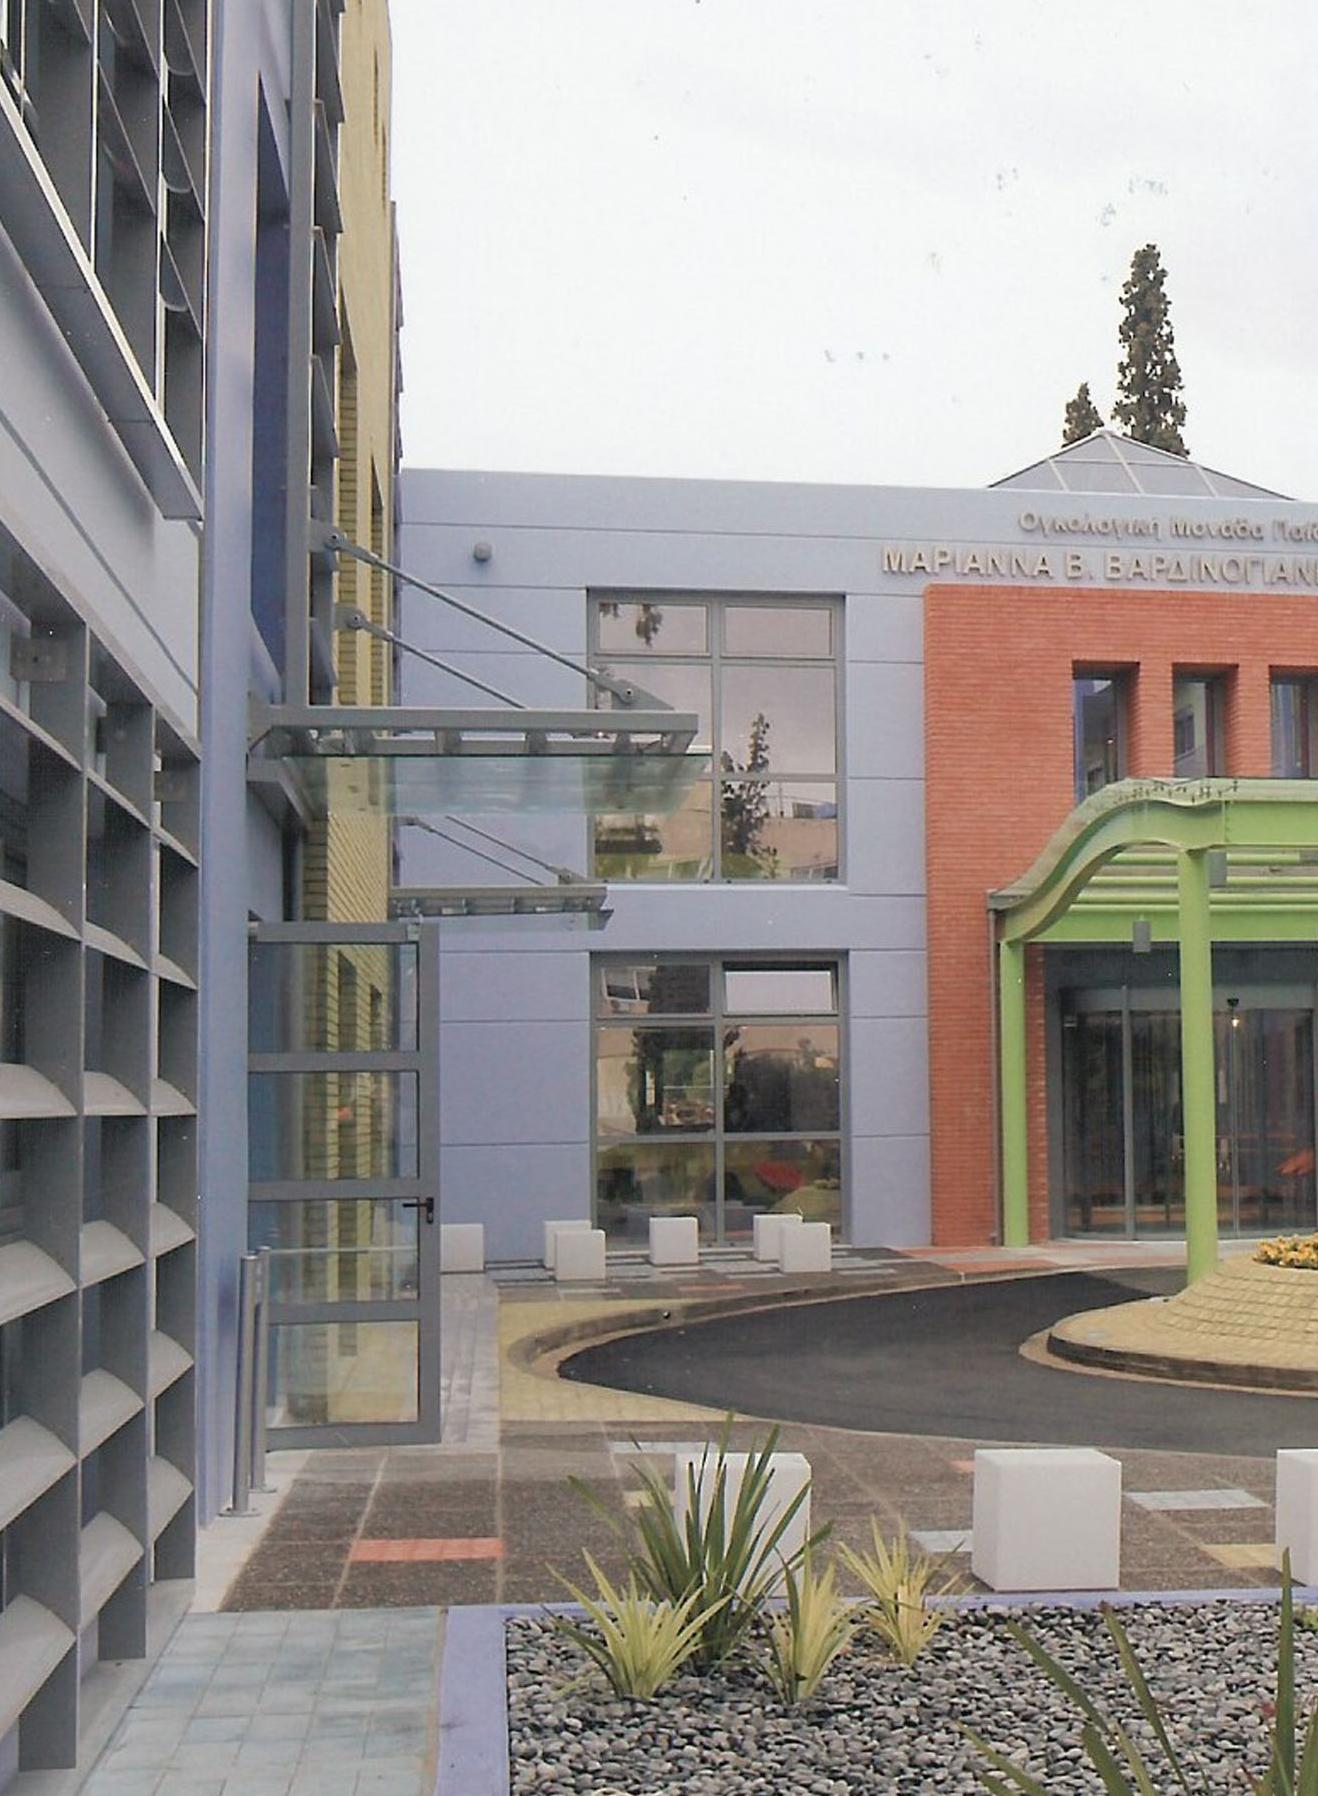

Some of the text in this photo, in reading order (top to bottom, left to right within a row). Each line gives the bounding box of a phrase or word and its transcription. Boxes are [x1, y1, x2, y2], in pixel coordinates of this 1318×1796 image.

[1018, 511, 1162, 540] Ογκολογική
[1168, 517, 1264, 541] Μονάδα
[881, 545, 1054, 578] ΜΑΡΙΑΝΝΑ
[1065, 551, 1094, 580] Β.
